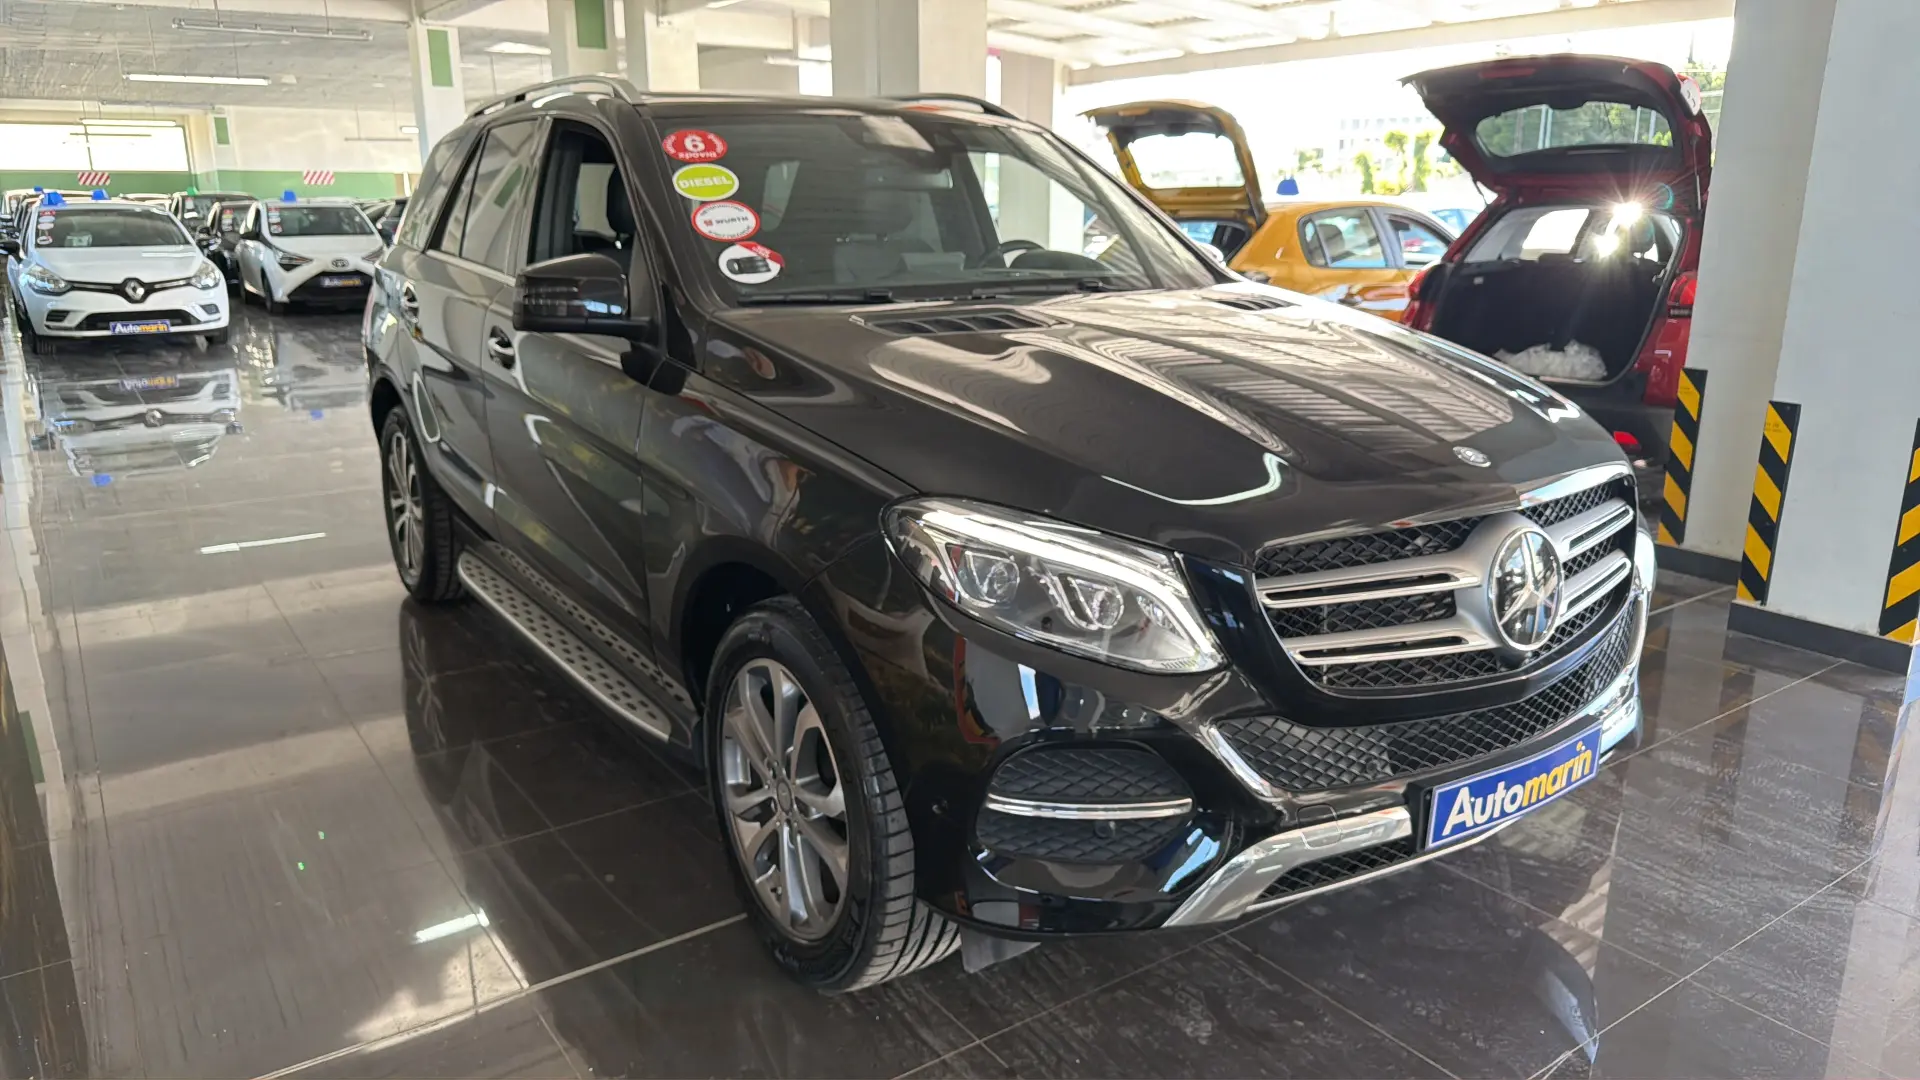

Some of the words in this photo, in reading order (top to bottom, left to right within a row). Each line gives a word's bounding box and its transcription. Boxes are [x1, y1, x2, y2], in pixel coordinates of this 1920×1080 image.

[684, 134, 705, 152] 6
[678, 176, 732, 189] DIESEL
[115, 320, 168, 334] Automarin
[1442, 740, 1593, 836] Automarin
